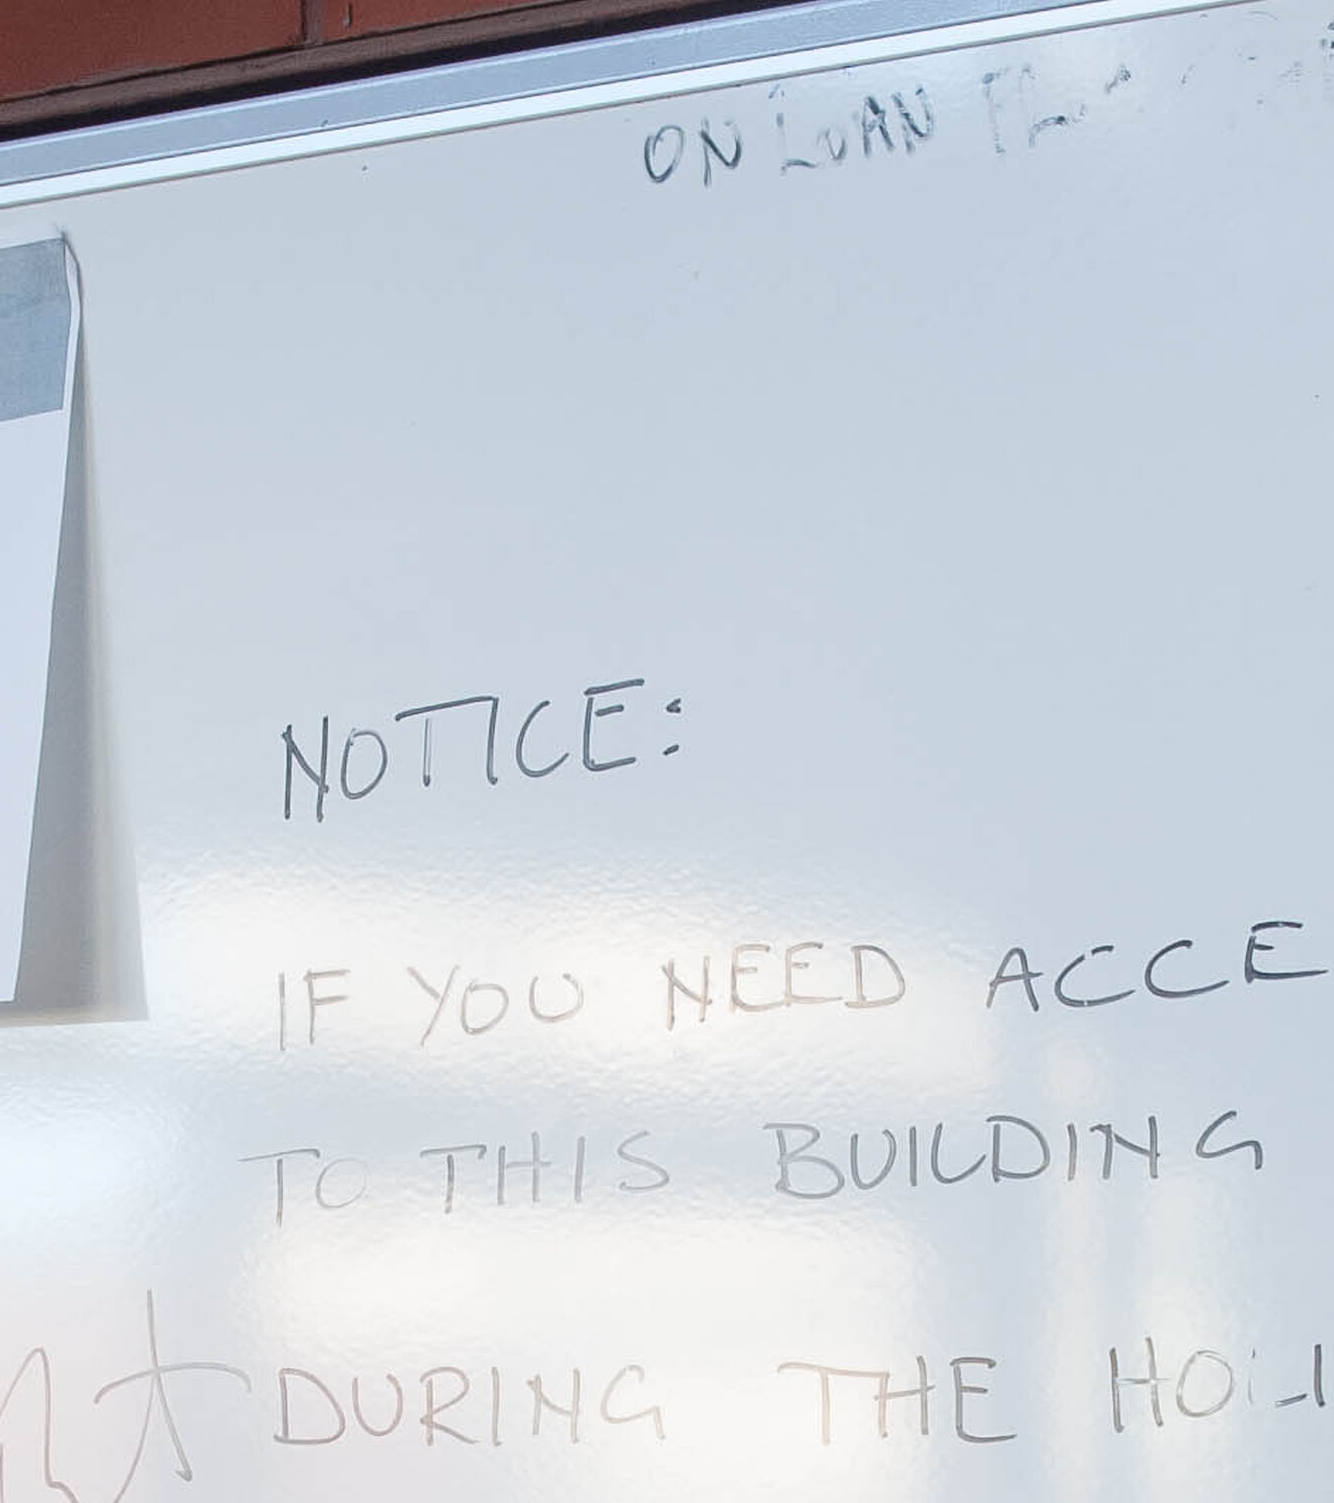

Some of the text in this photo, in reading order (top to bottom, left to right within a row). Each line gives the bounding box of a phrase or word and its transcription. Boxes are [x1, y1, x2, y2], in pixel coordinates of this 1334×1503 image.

[643, 123, 743, 187] ON
[280, 677, 684, 822] NOTICE:
[275, 965, 355, 1053] IF
[405, 961, 585, 1049] YOU
[657, 939, 909, 1032] NEED
[238, 1108, 1267, 1229] TO THIS BUILDING
[271, 1360, 670, 1448] DURING
[775, 1352, 1019, 1450] THE
